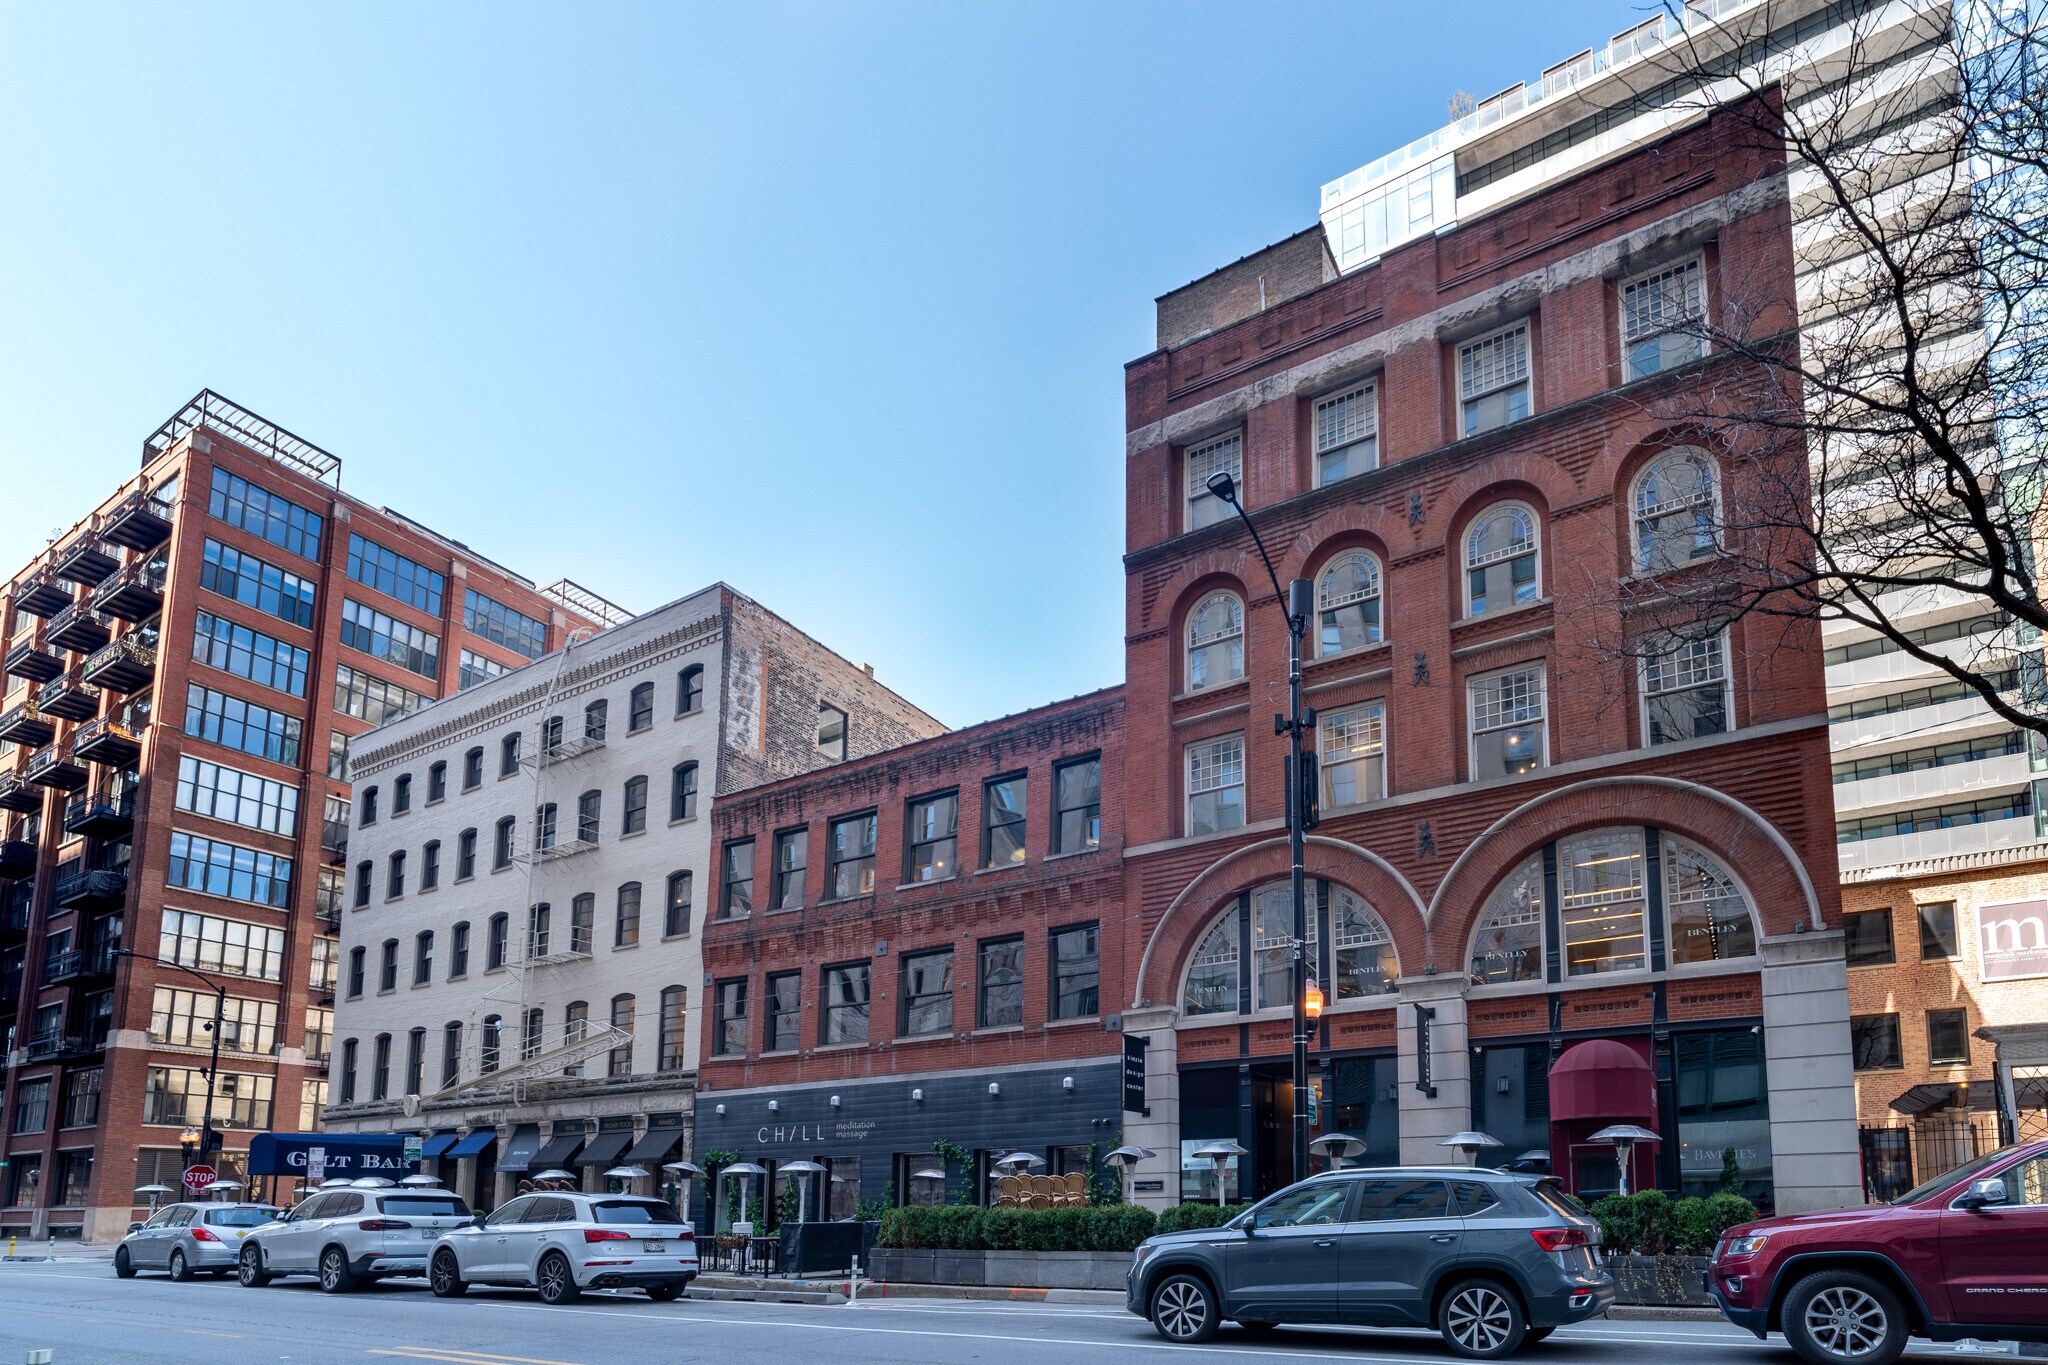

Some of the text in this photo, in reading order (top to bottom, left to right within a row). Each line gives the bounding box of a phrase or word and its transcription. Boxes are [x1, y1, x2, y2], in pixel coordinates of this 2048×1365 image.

[1687, 923, 1738, 937] BENTLEY
[1485, 949, 1529, 961] BENTLEY
[2017, 948, 2048, 957] marketin
[1349, 965, 1386, 976] BENTLEY
[1194, 984, 1227, 995] BENTLEY
[1127, 1054, 1143, 1064] kinzie
[1126, 1068, 1144, 1078] design
[1126, 1083, 1144, 1091] center
[835, 1120, 876, 1131] meditation
[835, 1130, 869, 1140] massage
[286, 1151, 352, 1168] GLT
[186, 1172, 215, 1183] STOP
